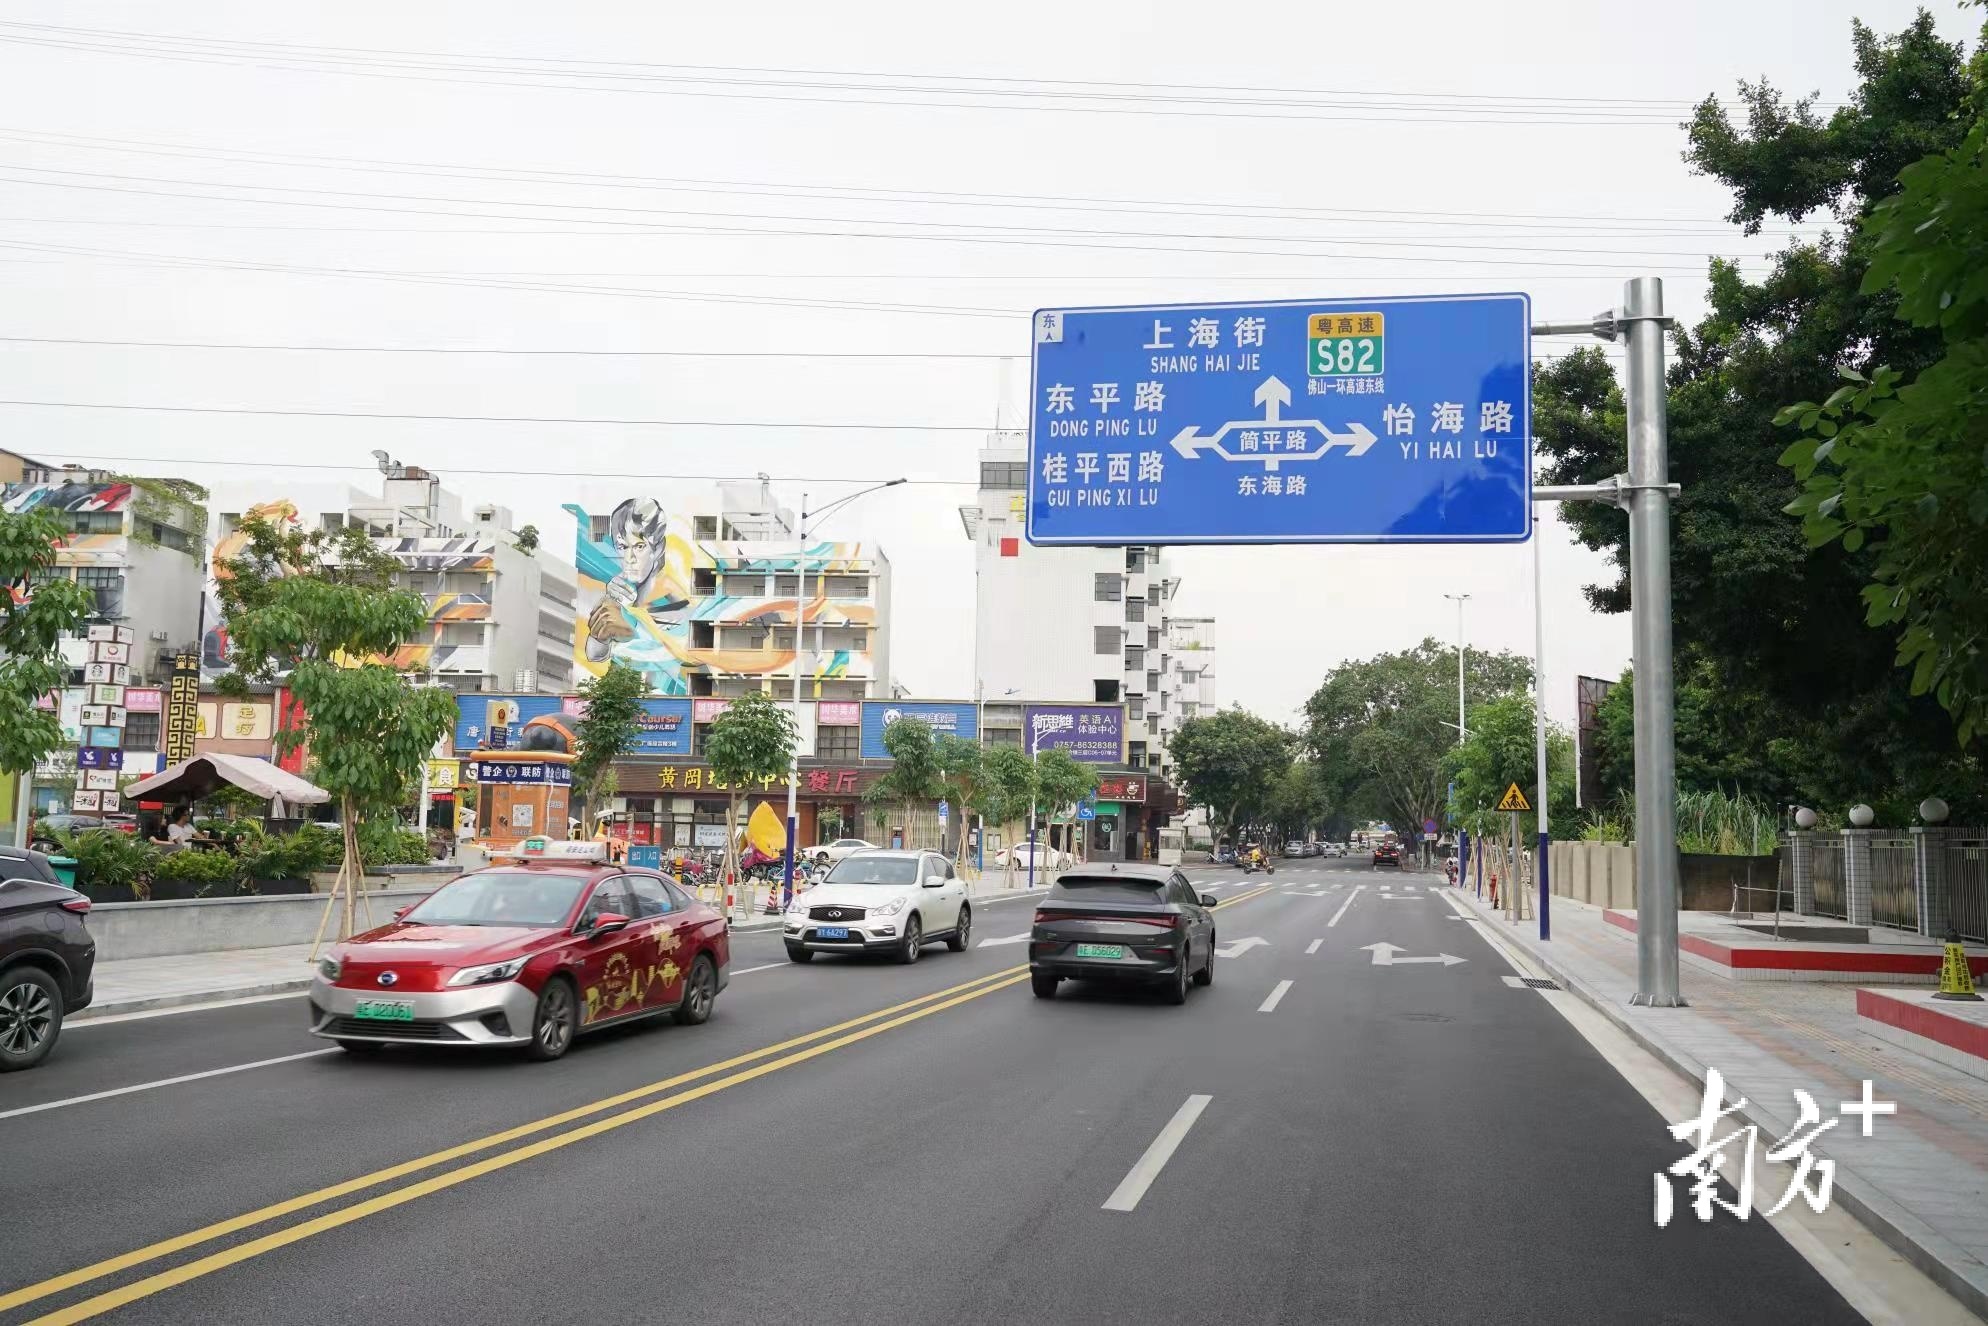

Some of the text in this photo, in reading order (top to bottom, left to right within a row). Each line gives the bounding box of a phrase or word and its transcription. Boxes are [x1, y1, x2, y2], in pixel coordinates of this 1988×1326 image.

[1042, 313, 1056, 329] 东
[1317, 317, 1375, 334] 粤高速
[1143, 316, 1267, 350] 上海街
[1151, 353, 1261, 373] SHANG HAI JIE
[1318, 338, 1374, 373] S82
[1308, 377, 1385, 396] 佛山一环高速东线
[1045, 380, 1167, 415] 东平路
[1050, 417, 1157, 438] DONG PING LU
[1383, 400, 1513, 436] 怡海路
[1239, 429, 1307, 452] 简平路
[1400, 440, 1497, 460] YI HAI LU
[1042, 449, 1165, 485] 桂平西路
[1237, 475, 1308, 496] 东海路
[1047, 488, 1158, 507] GUI PING XI LU
[1078, 725, 1117, 734] 体验中心
[482, 766, 542, 778] 警企 联防
[808, 769, 859, 793] 餐厅
[648, 851, 657, 861] 入口
